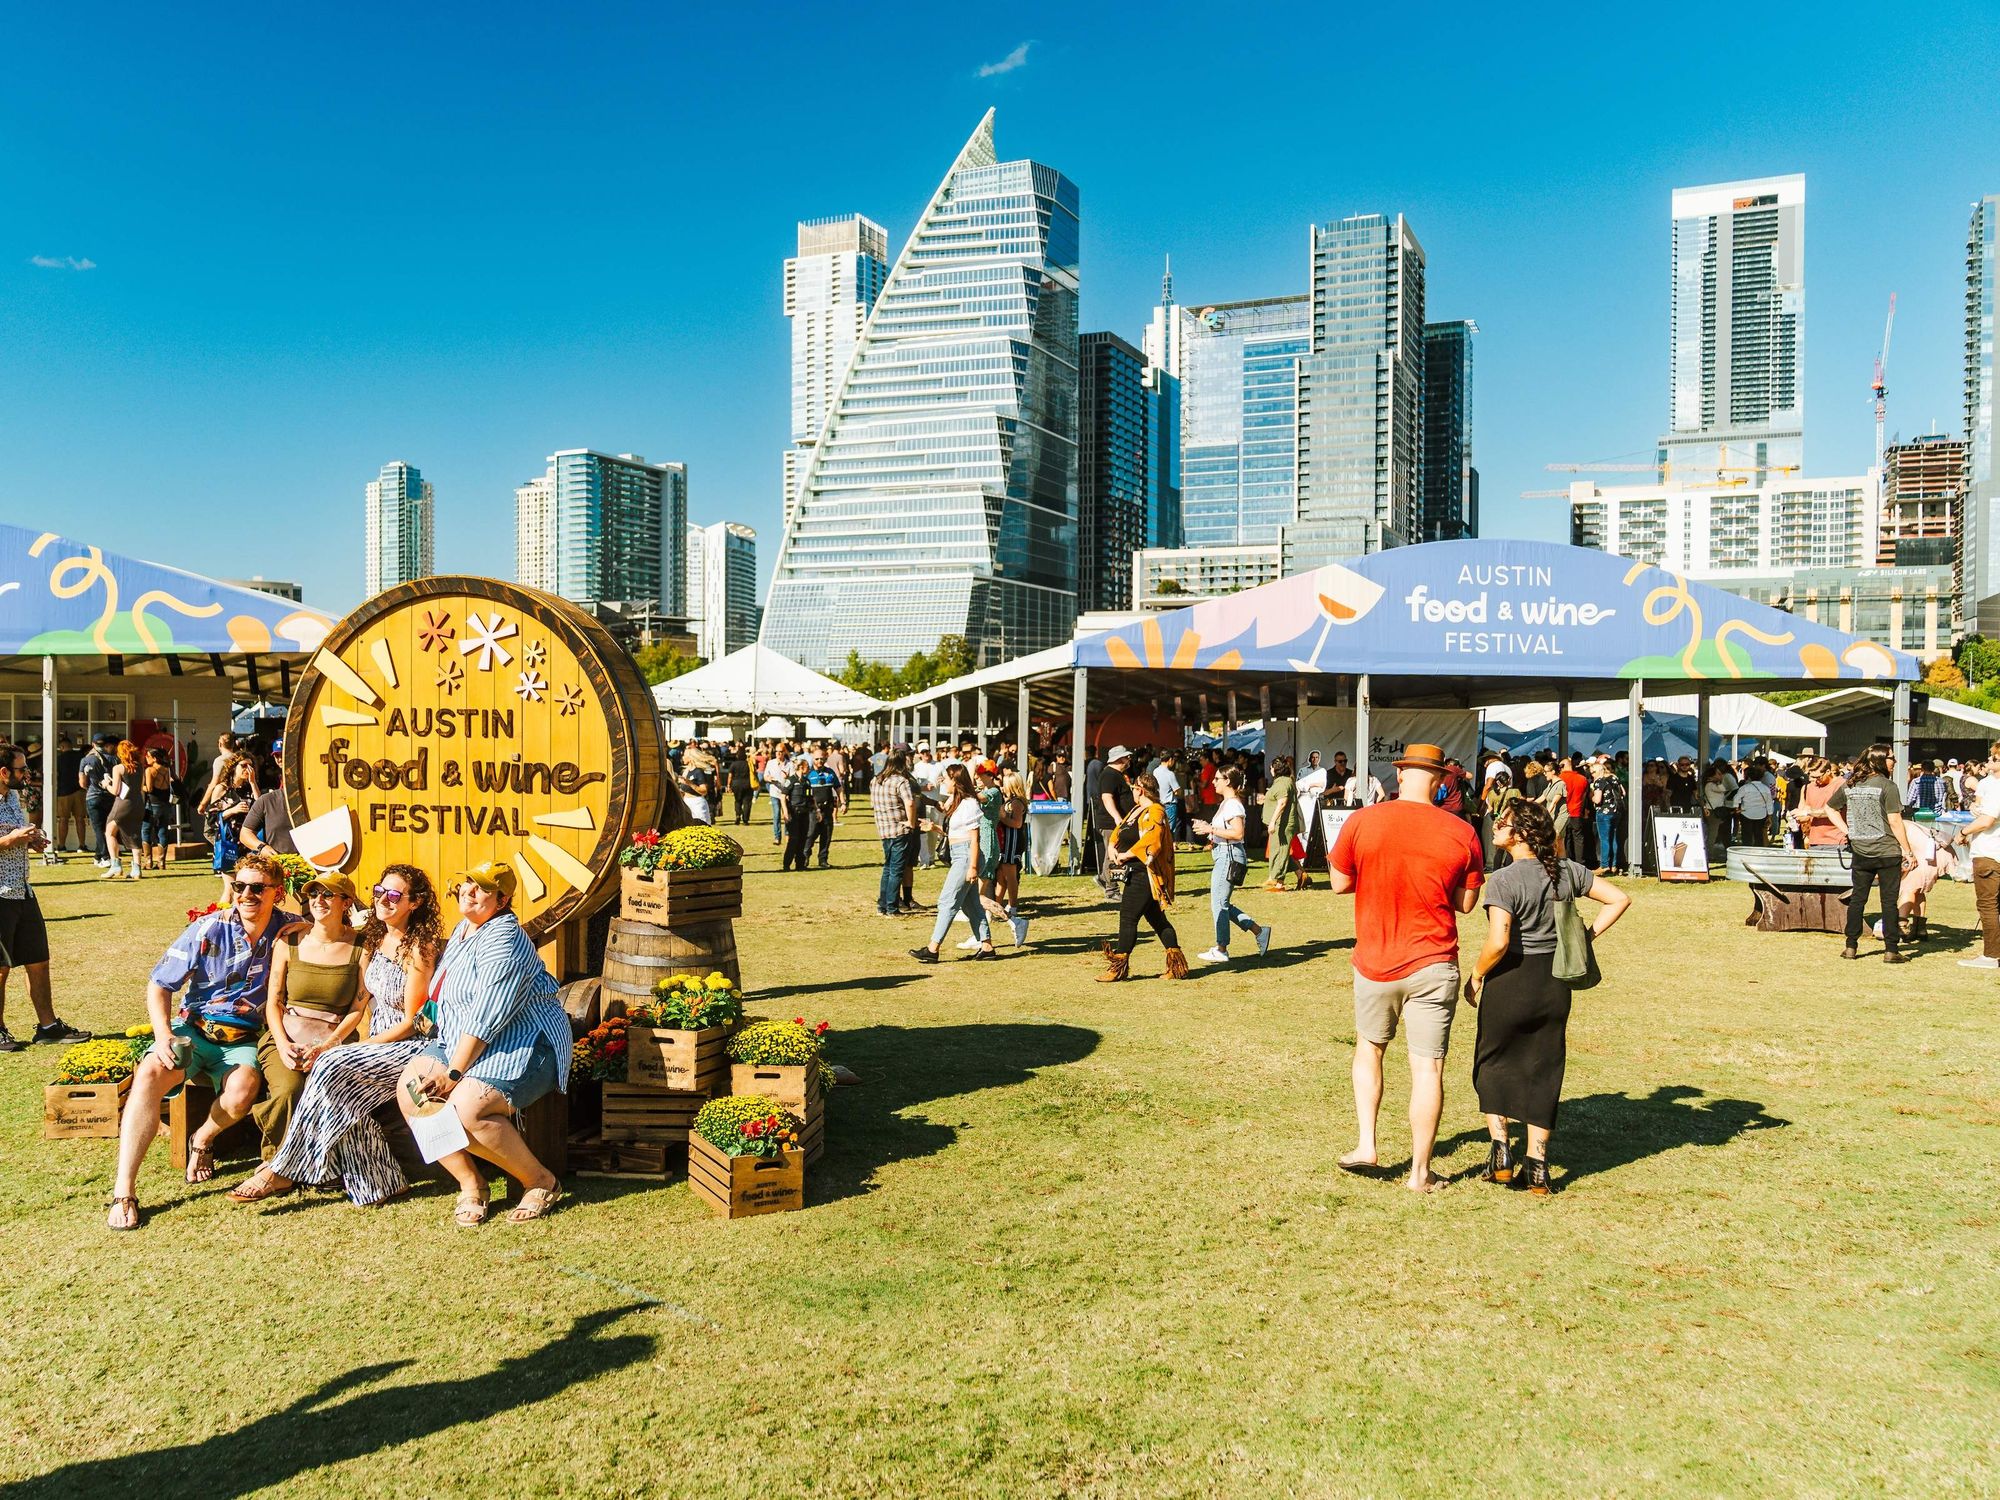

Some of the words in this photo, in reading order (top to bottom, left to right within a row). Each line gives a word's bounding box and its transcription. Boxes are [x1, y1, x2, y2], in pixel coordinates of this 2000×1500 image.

[1457, 564, 1552, 587] AUSTIN
[1880, 568, 1908, 576] SILICON
[1404, 584, 1488, 623] food
[1497, 601, 1514, 621] &
[1520, 596, 1616, 626] wine
[1445, 632, 1564, 655] FESTIVAL
[385, 707, 514, 739] AUSTIN
[320, 738, 428, 791] food
[441, 759, 463, 787] &
[472, 753, 606, 795] wine
[369, 803, 530, 837] FESTIVAL
[628, 896, 642, 907] food
